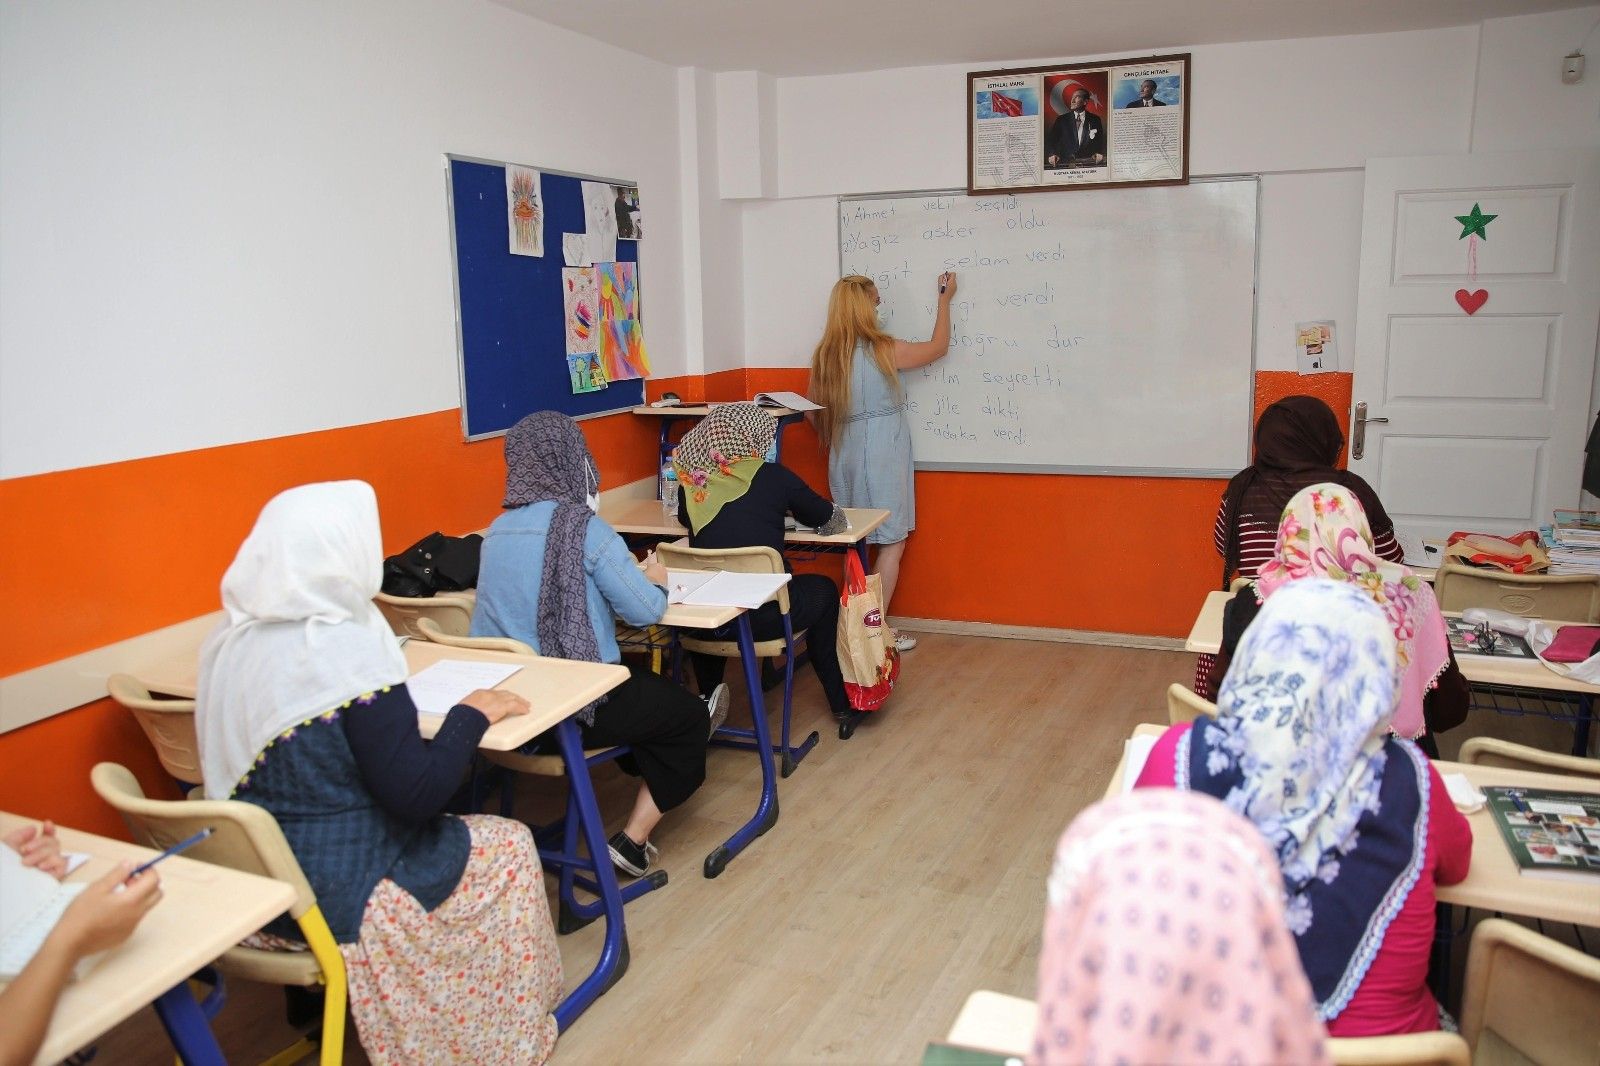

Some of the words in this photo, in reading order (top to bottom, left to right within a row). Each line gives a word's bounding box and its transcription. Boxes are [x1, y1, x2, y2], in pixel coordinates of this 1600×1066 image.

[922, 197, 955, 210] vekil
[922, 220, 976, 240] asker
[1006, 209, 1046, 230] oldu
[943, 249, 1010, 271] selam
[1025, 241, 1065, 262] verdi
[996, 281, 1054, 307] verdi
[1046, 323, 1086, 349] dur
[982, 364, 1063, 393] seyretti
[981, 395, 1020, 421] dikti
